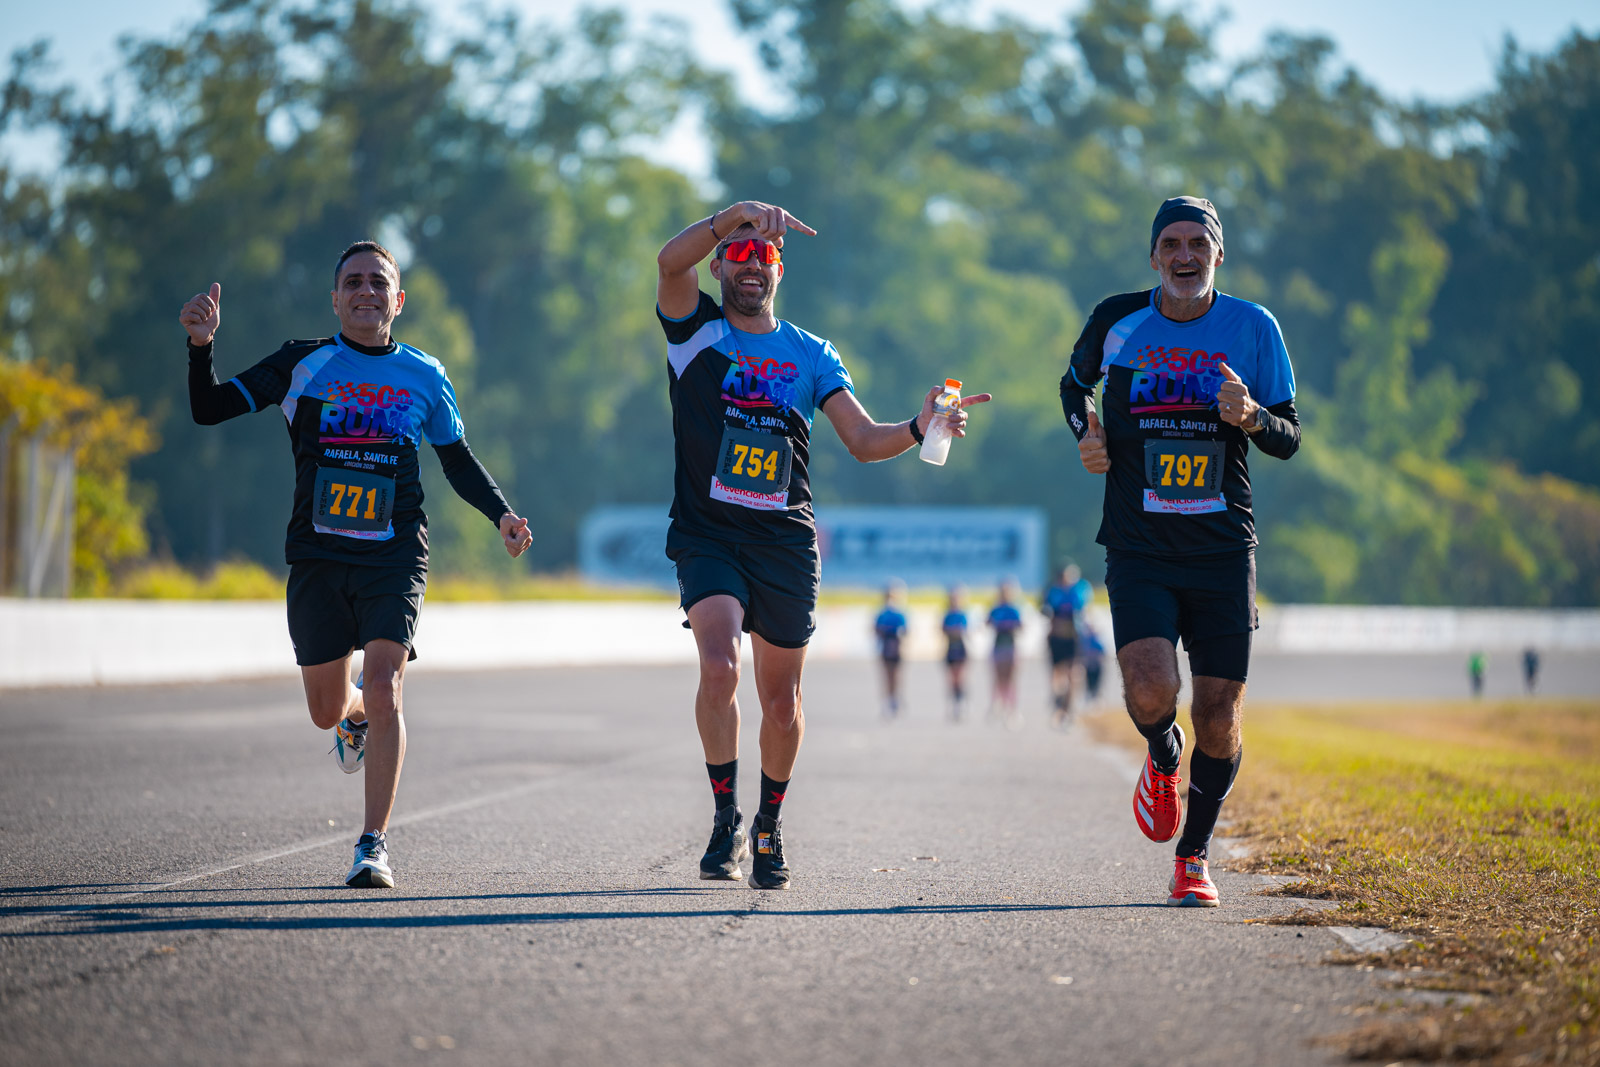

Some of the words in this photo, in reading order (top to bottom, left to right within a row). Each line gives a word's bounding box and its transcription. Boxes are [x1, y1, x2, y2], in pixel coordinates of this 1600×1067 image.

[387, 395, 414, 406] MILLAS
[1139, 419, 1178, 430] RAFAELA,
[1180, 420, 1207, 432] SANTA
[1208, 423, 1218, 432] FE
[323, 448, 361, 461] RAFAELA,
[363, 451, 389, 465] SANTA
[389, 455, 399, 465] FE
[731, 444, 779, 481] 754
[1160, 454, 1209, 487] 797
[329, 483, 377, 520] 771
